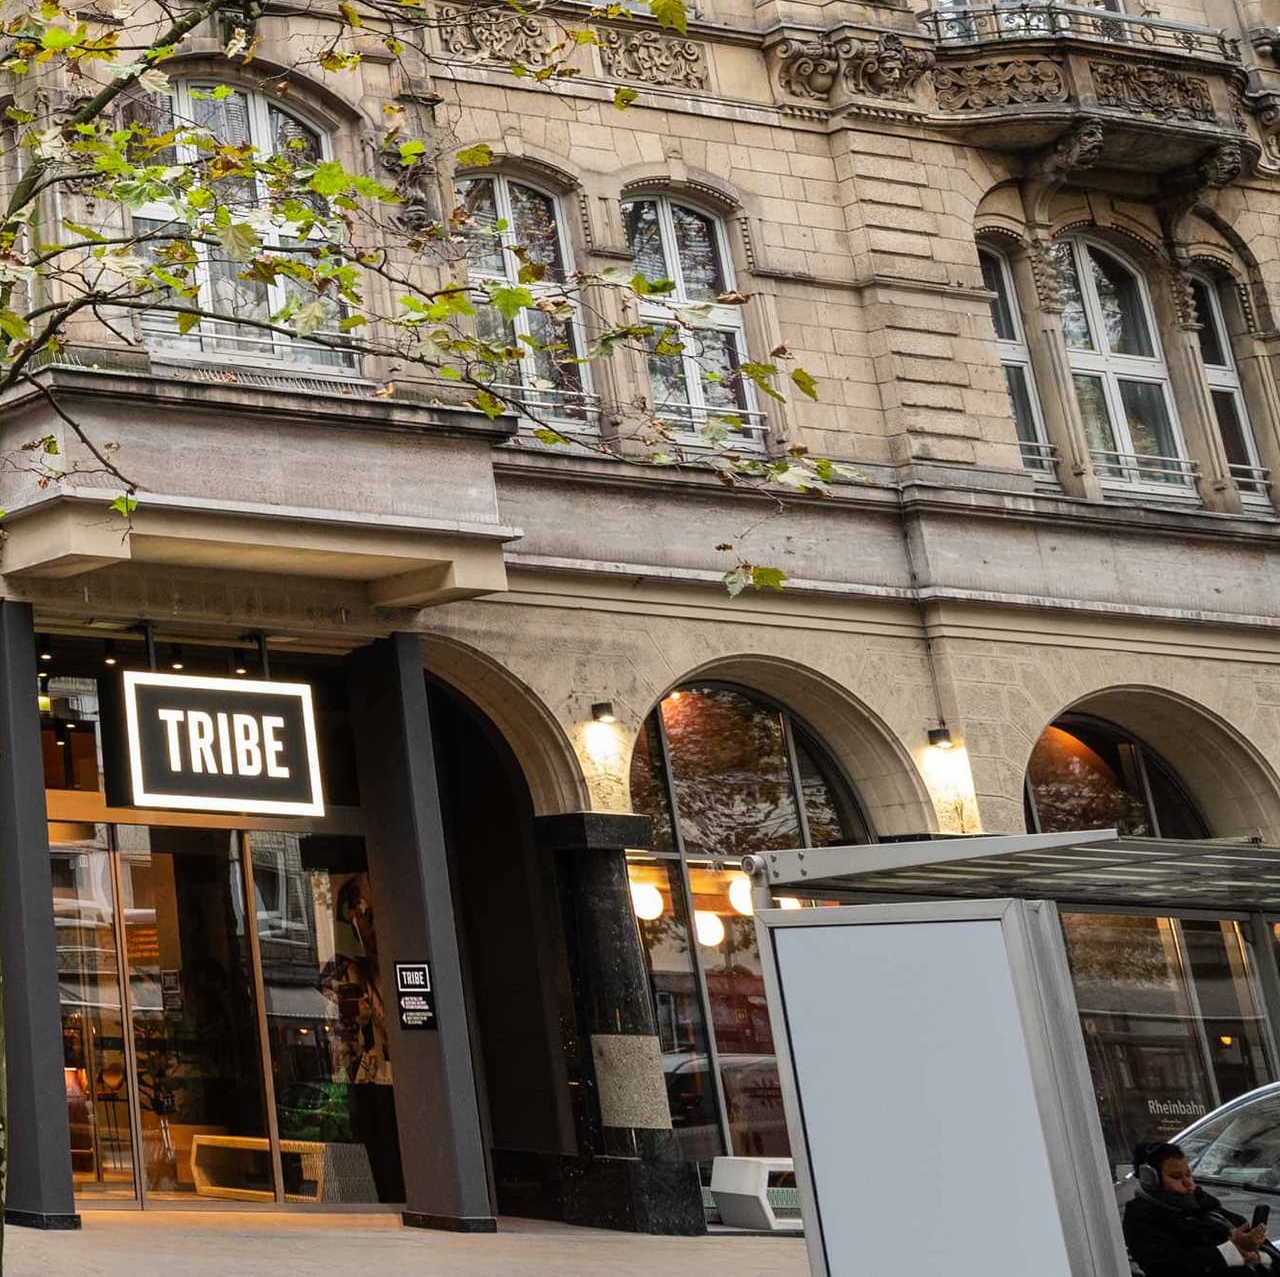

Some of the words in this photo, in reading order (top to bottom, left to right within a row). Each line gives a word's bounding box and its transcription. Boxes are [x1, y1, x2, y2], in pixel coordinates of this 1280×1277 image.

[158, 708, 290, 778] TRIBE
[401, 971, 425, 985] TRIBE
[1147, 1099, 1207, 1115] Rheinbahn
